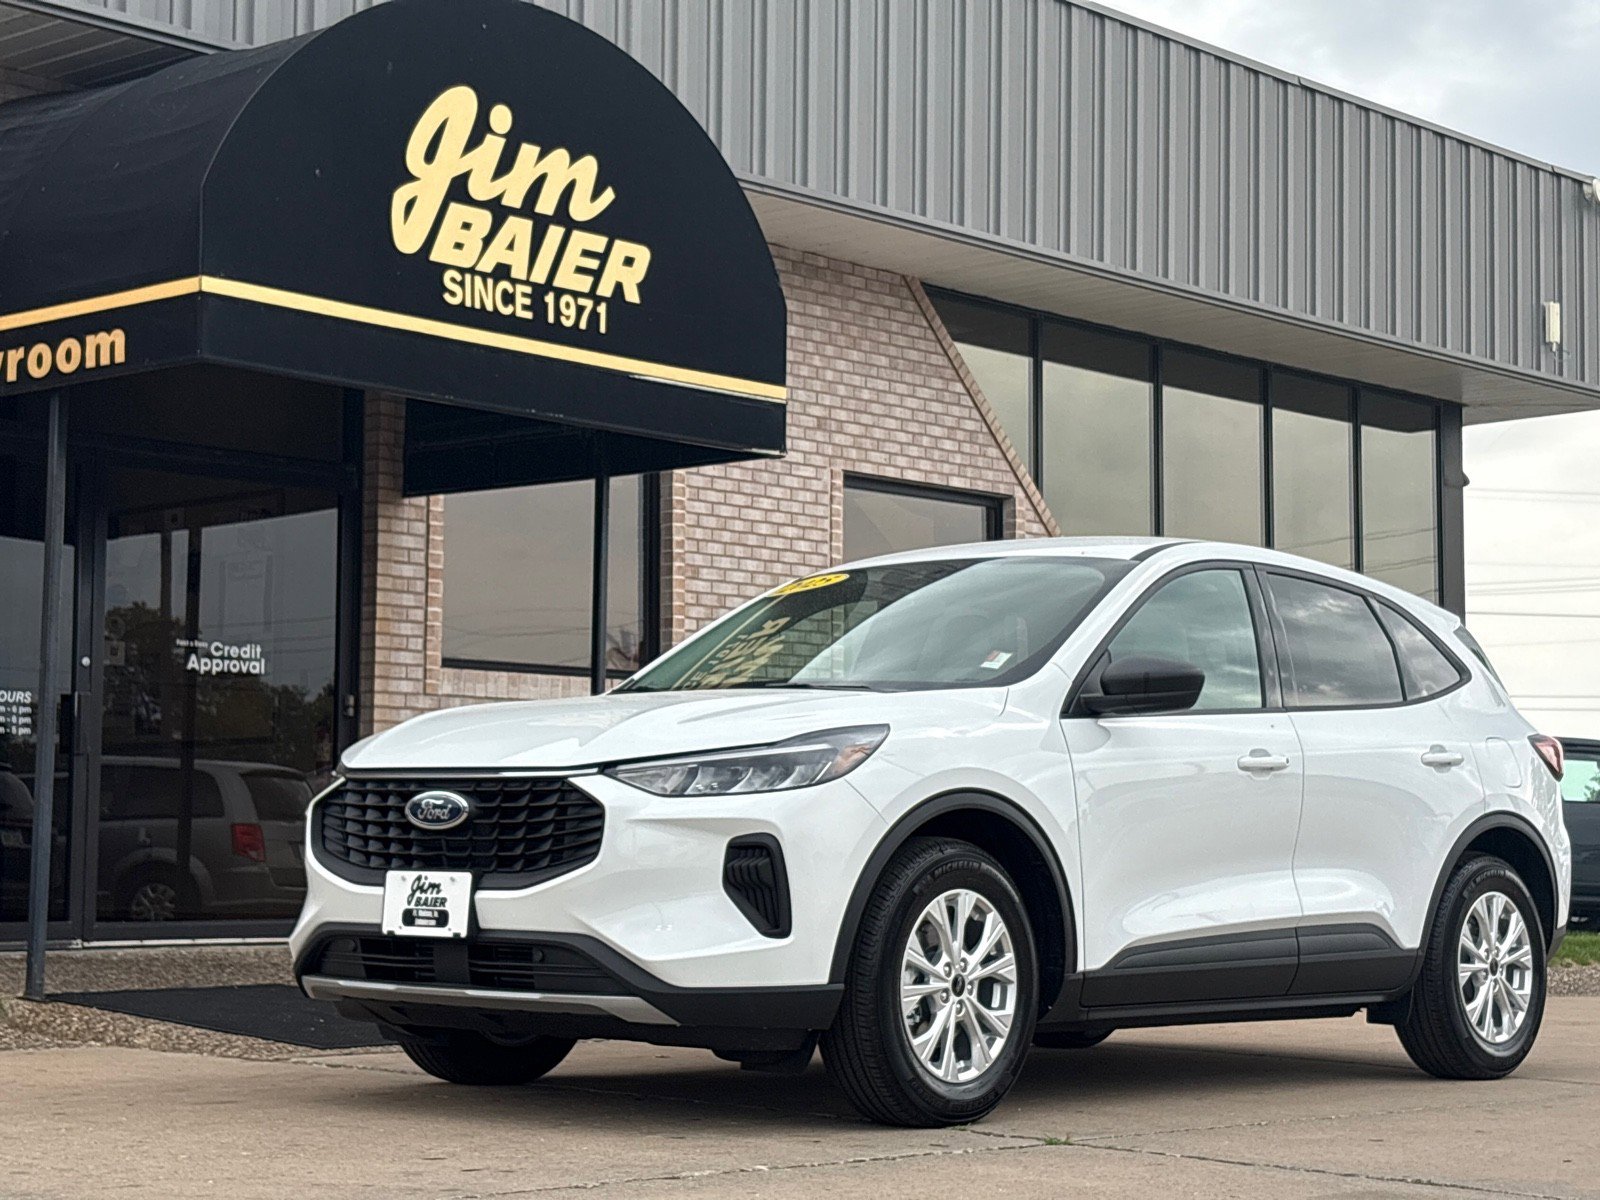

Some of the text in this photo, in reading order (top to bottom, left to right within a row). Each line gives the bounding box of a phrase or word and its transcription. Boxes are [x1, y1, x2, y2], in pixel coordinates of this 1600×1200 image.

[392, 85, 616, 255] Jim
[429, 202, 651, 304] BAIER
[443, 269, 607, 334] SINCE 1971
[210, 641, 262, 659] Credit
[186, 653, 265, 676] Approval
[417, 798, 453, 820] Ford
[407, 874, 442, 906] Jim
[414, 896, 448, 908] BAIER
